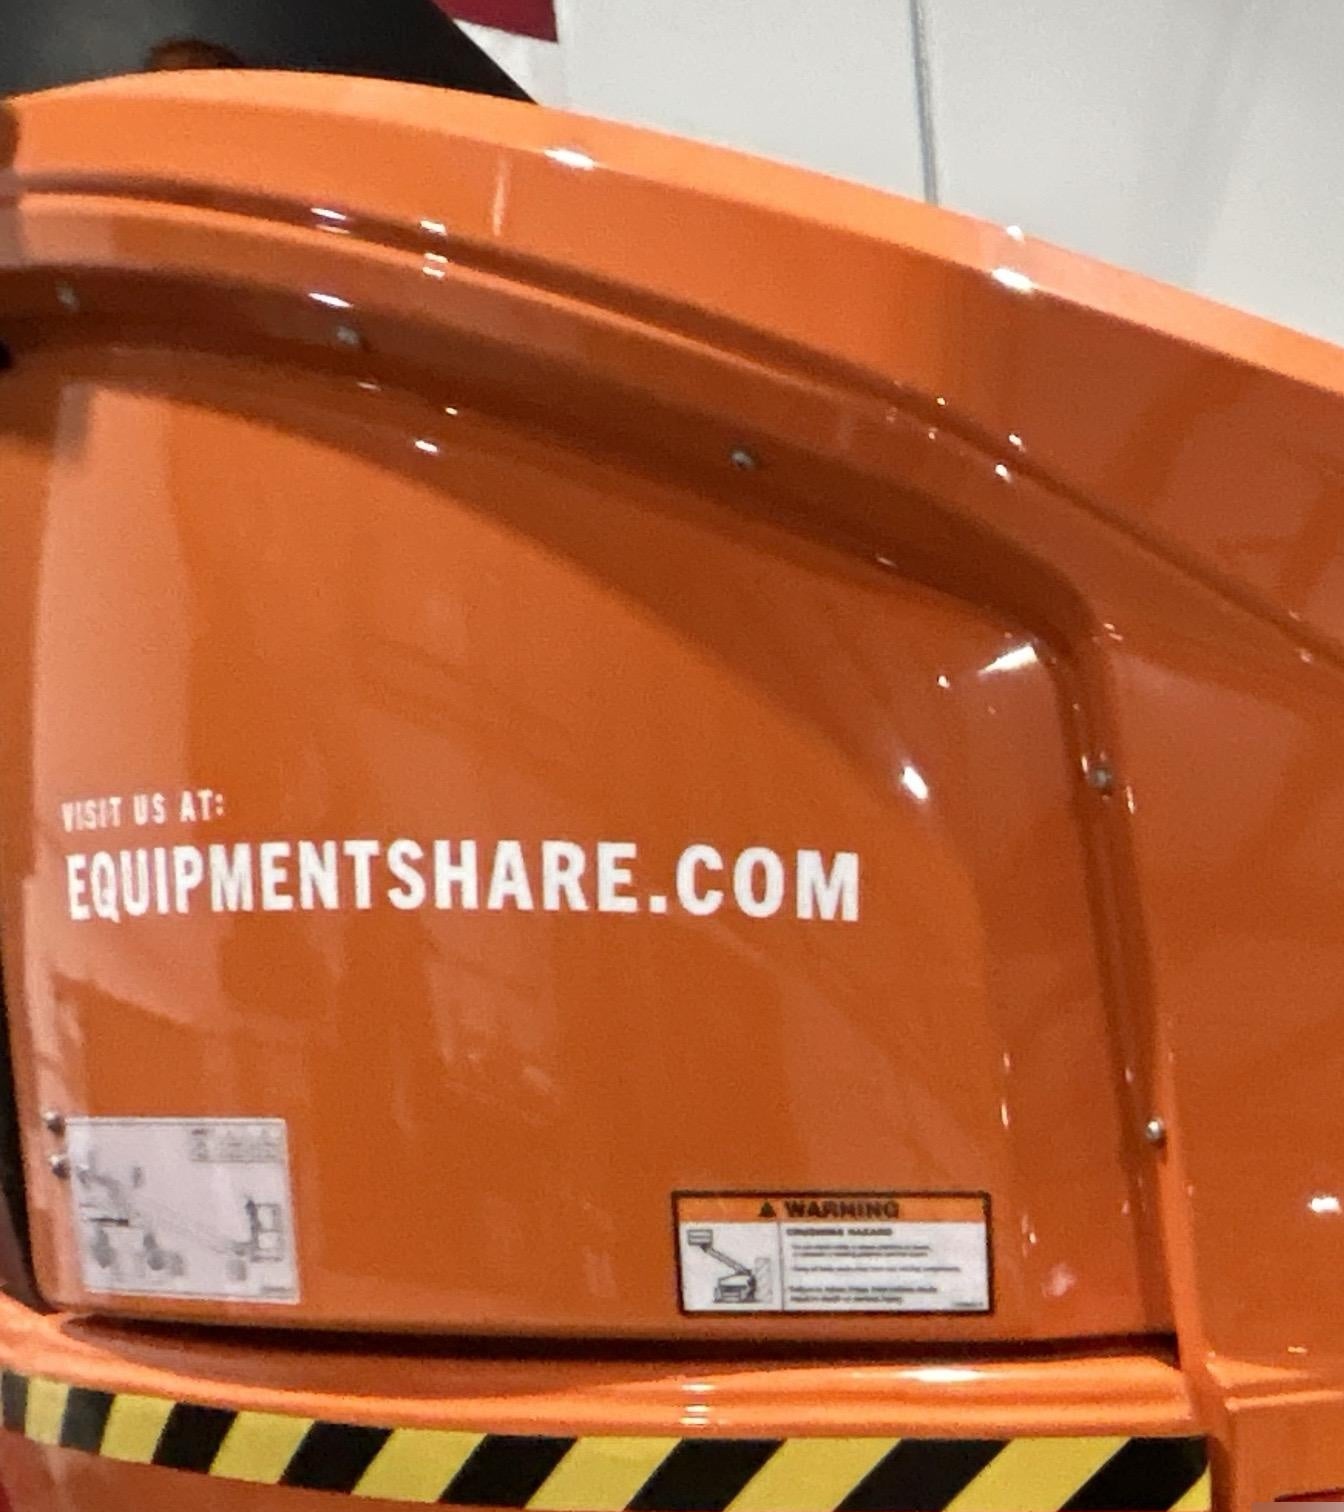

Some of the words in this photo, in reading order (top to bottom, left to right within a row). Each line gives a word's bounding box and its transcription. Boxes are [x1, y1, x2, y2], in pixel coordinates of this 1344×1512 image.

[61, 797, 122, 832] VISIT
[133, 793, 167, 825] US
[180, 789, 225, 823] AT:
[66, 838, 860, 923] EQUIPMENTSHARE.COM
[784, 1200, 900, 1219] WARNING
